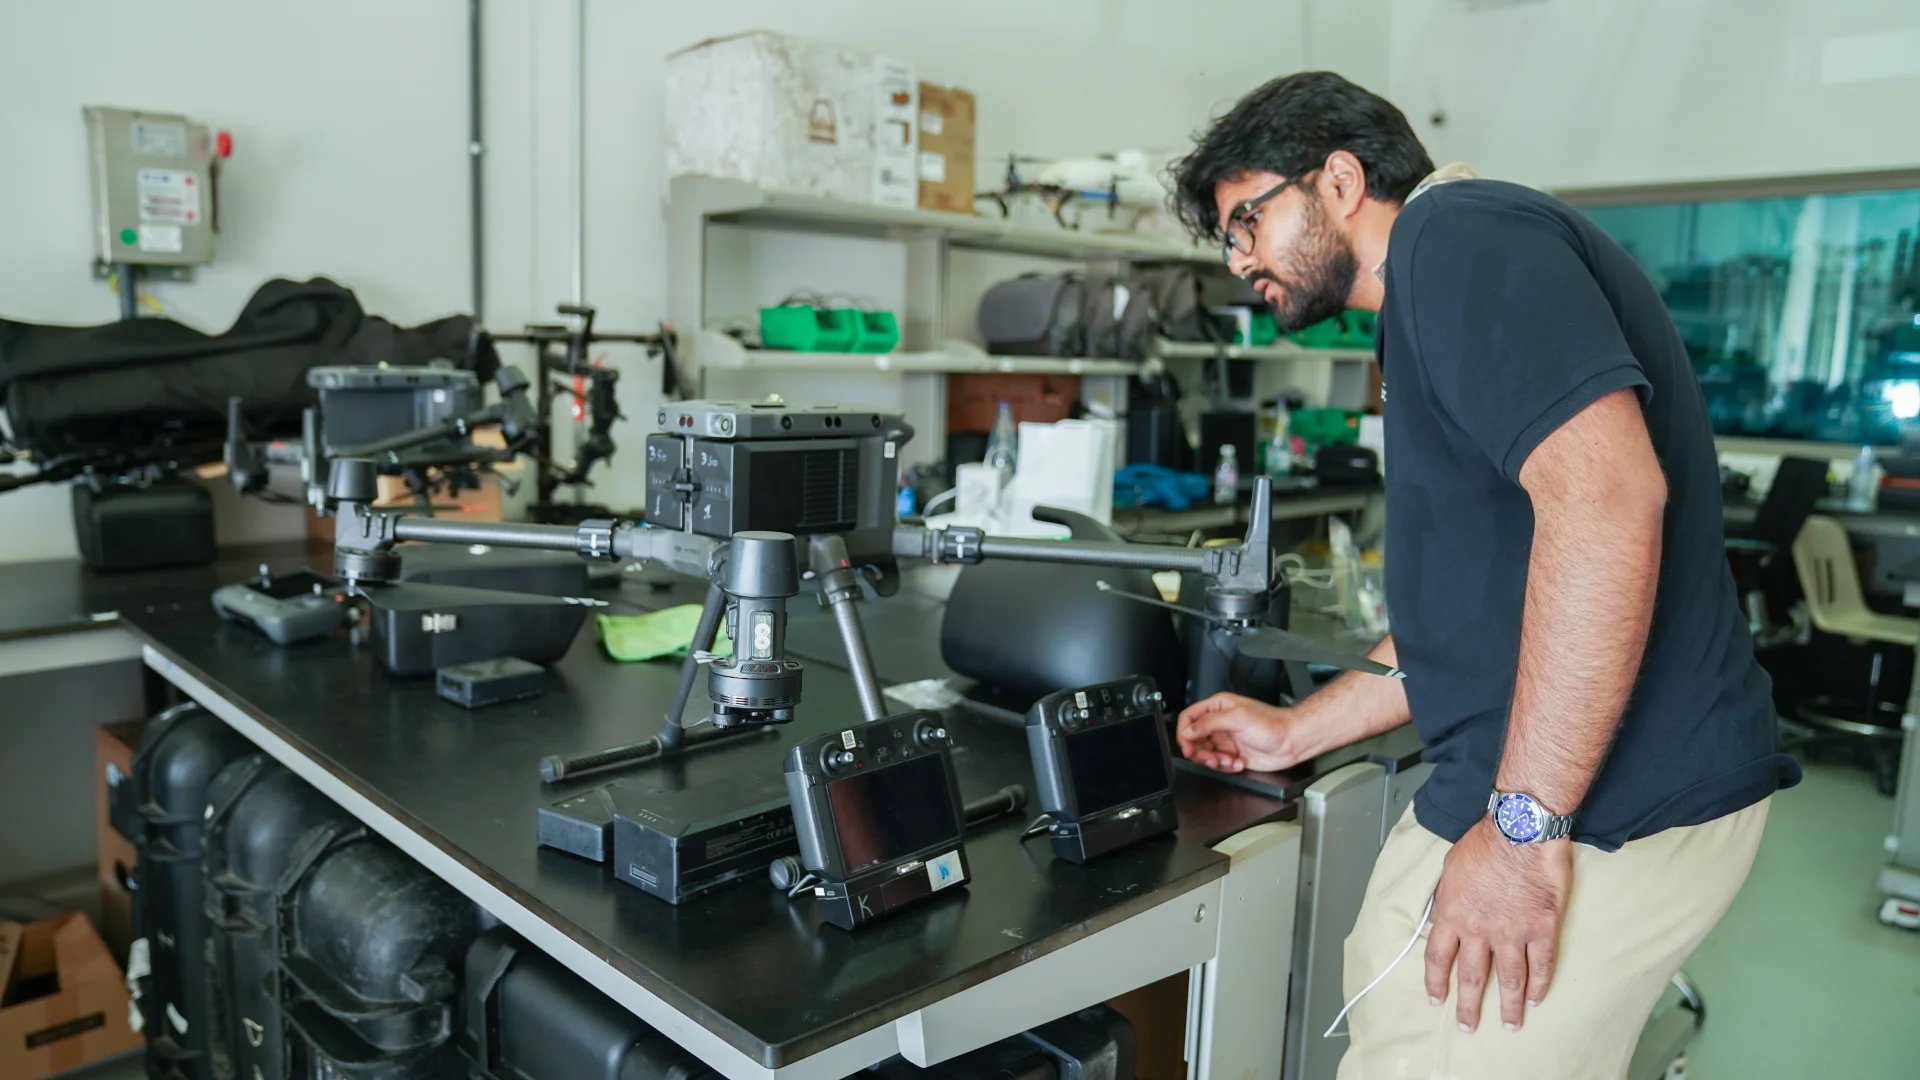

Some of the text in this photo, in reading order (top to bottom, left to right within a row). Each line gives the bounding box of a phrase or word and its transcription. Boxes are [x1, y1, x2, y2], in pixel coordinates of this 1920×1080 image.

[700, 451, 718, 467] 350
[703, 503, 712, 520] 1
[857, 894, 874, 921] K
